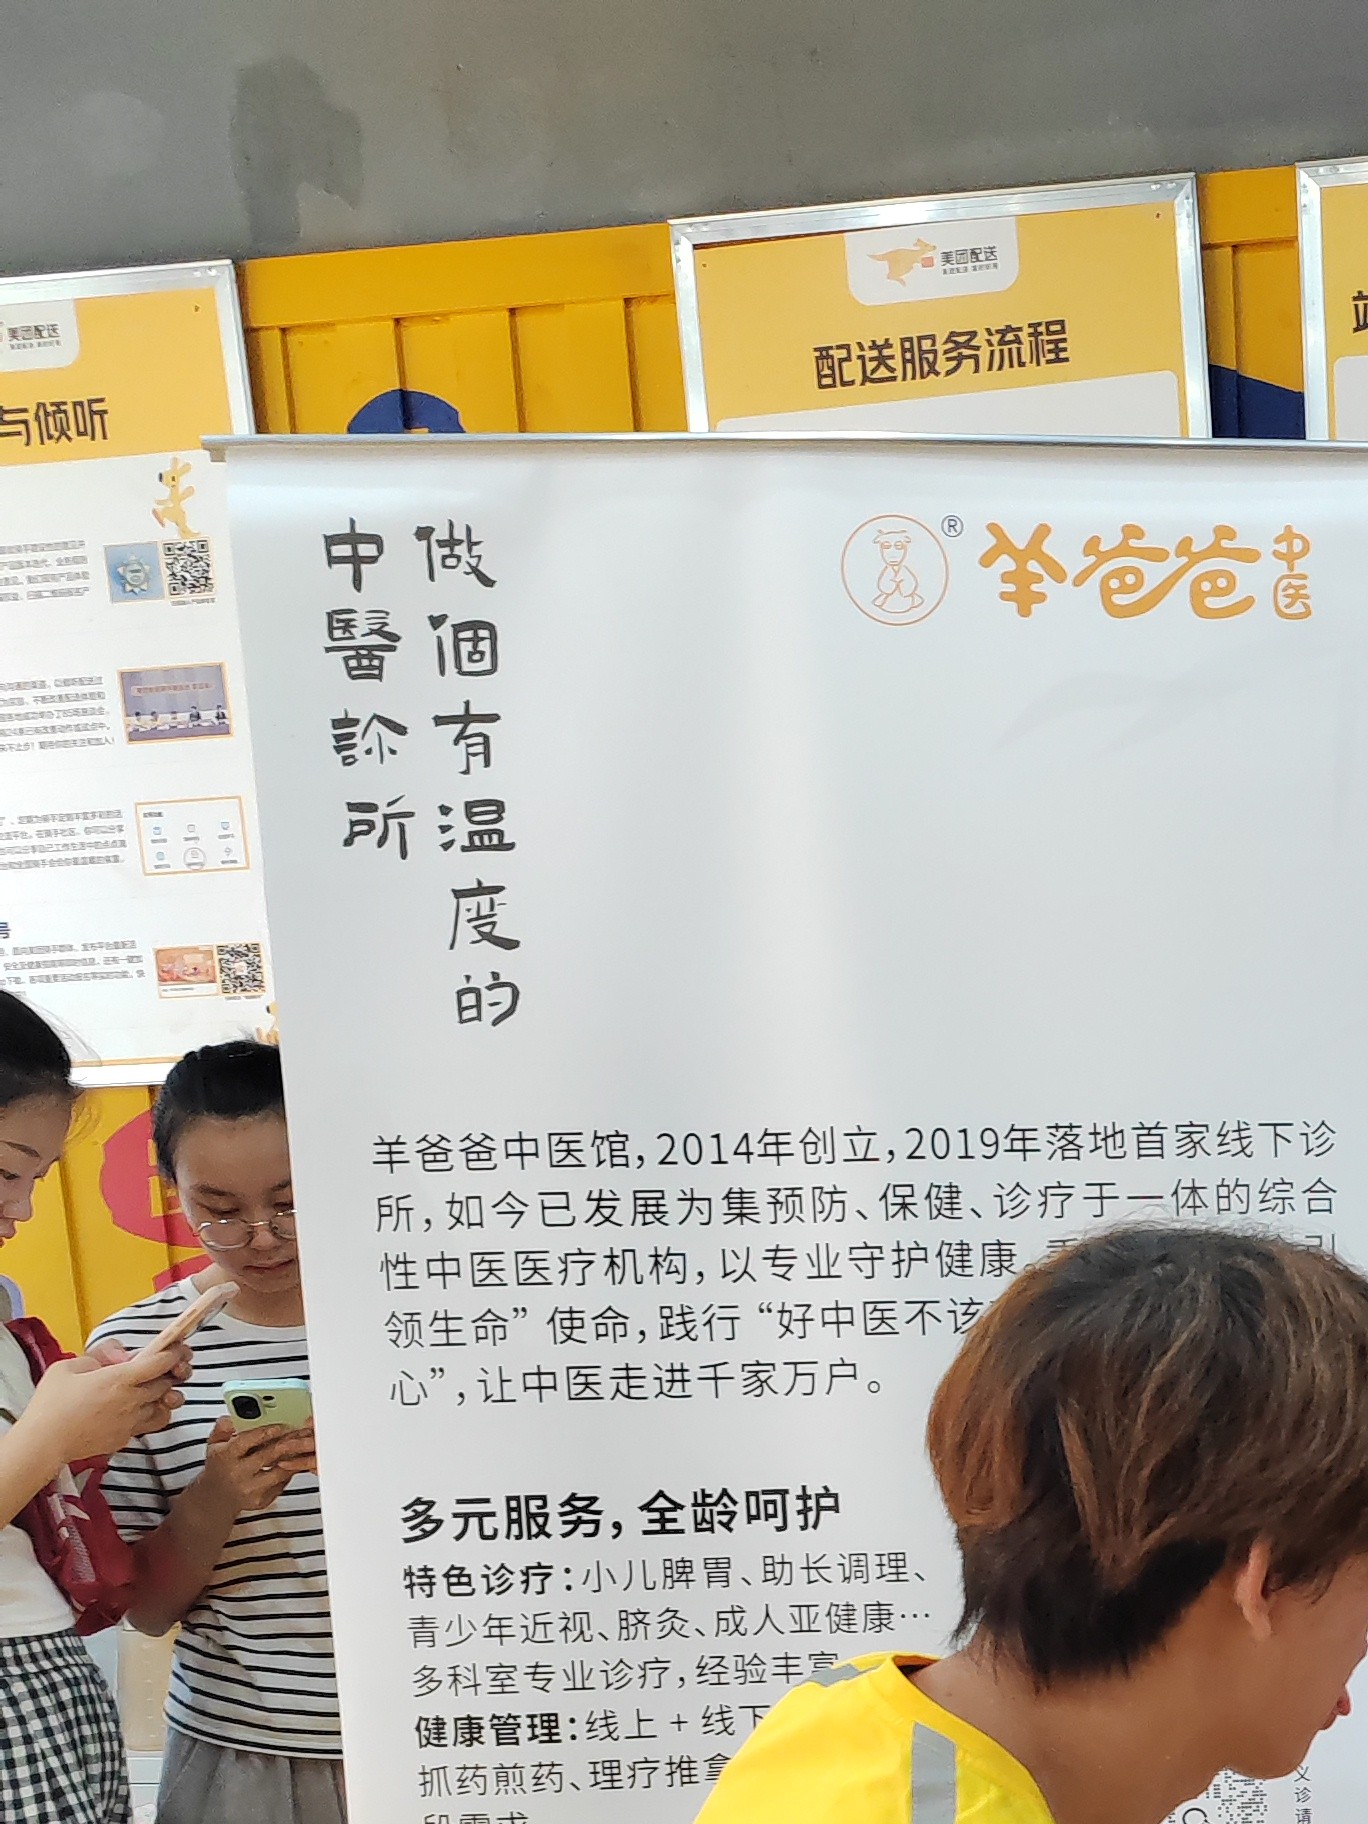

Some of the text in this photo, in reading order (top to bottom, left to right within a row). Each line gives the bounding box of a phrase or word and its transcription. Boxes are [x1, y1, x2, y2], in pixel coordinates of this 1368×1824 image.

[813, 318, 1071, 390] 配送服务流程
[0, 397, 108, 446] 与倾听
[978, 521, 1313, 621] 羊爸爸 中医
[372, 1119, 1338, 1175] 羊爸爸中医馆，2014年创立，2019年落地首家线下诊
[376, 1176, 1339, 1233] 所，如今已发展为集预防、保健、诊疗于一体的综合
[401, 1484, 842, 1544] 多元服务，全龄呵护
